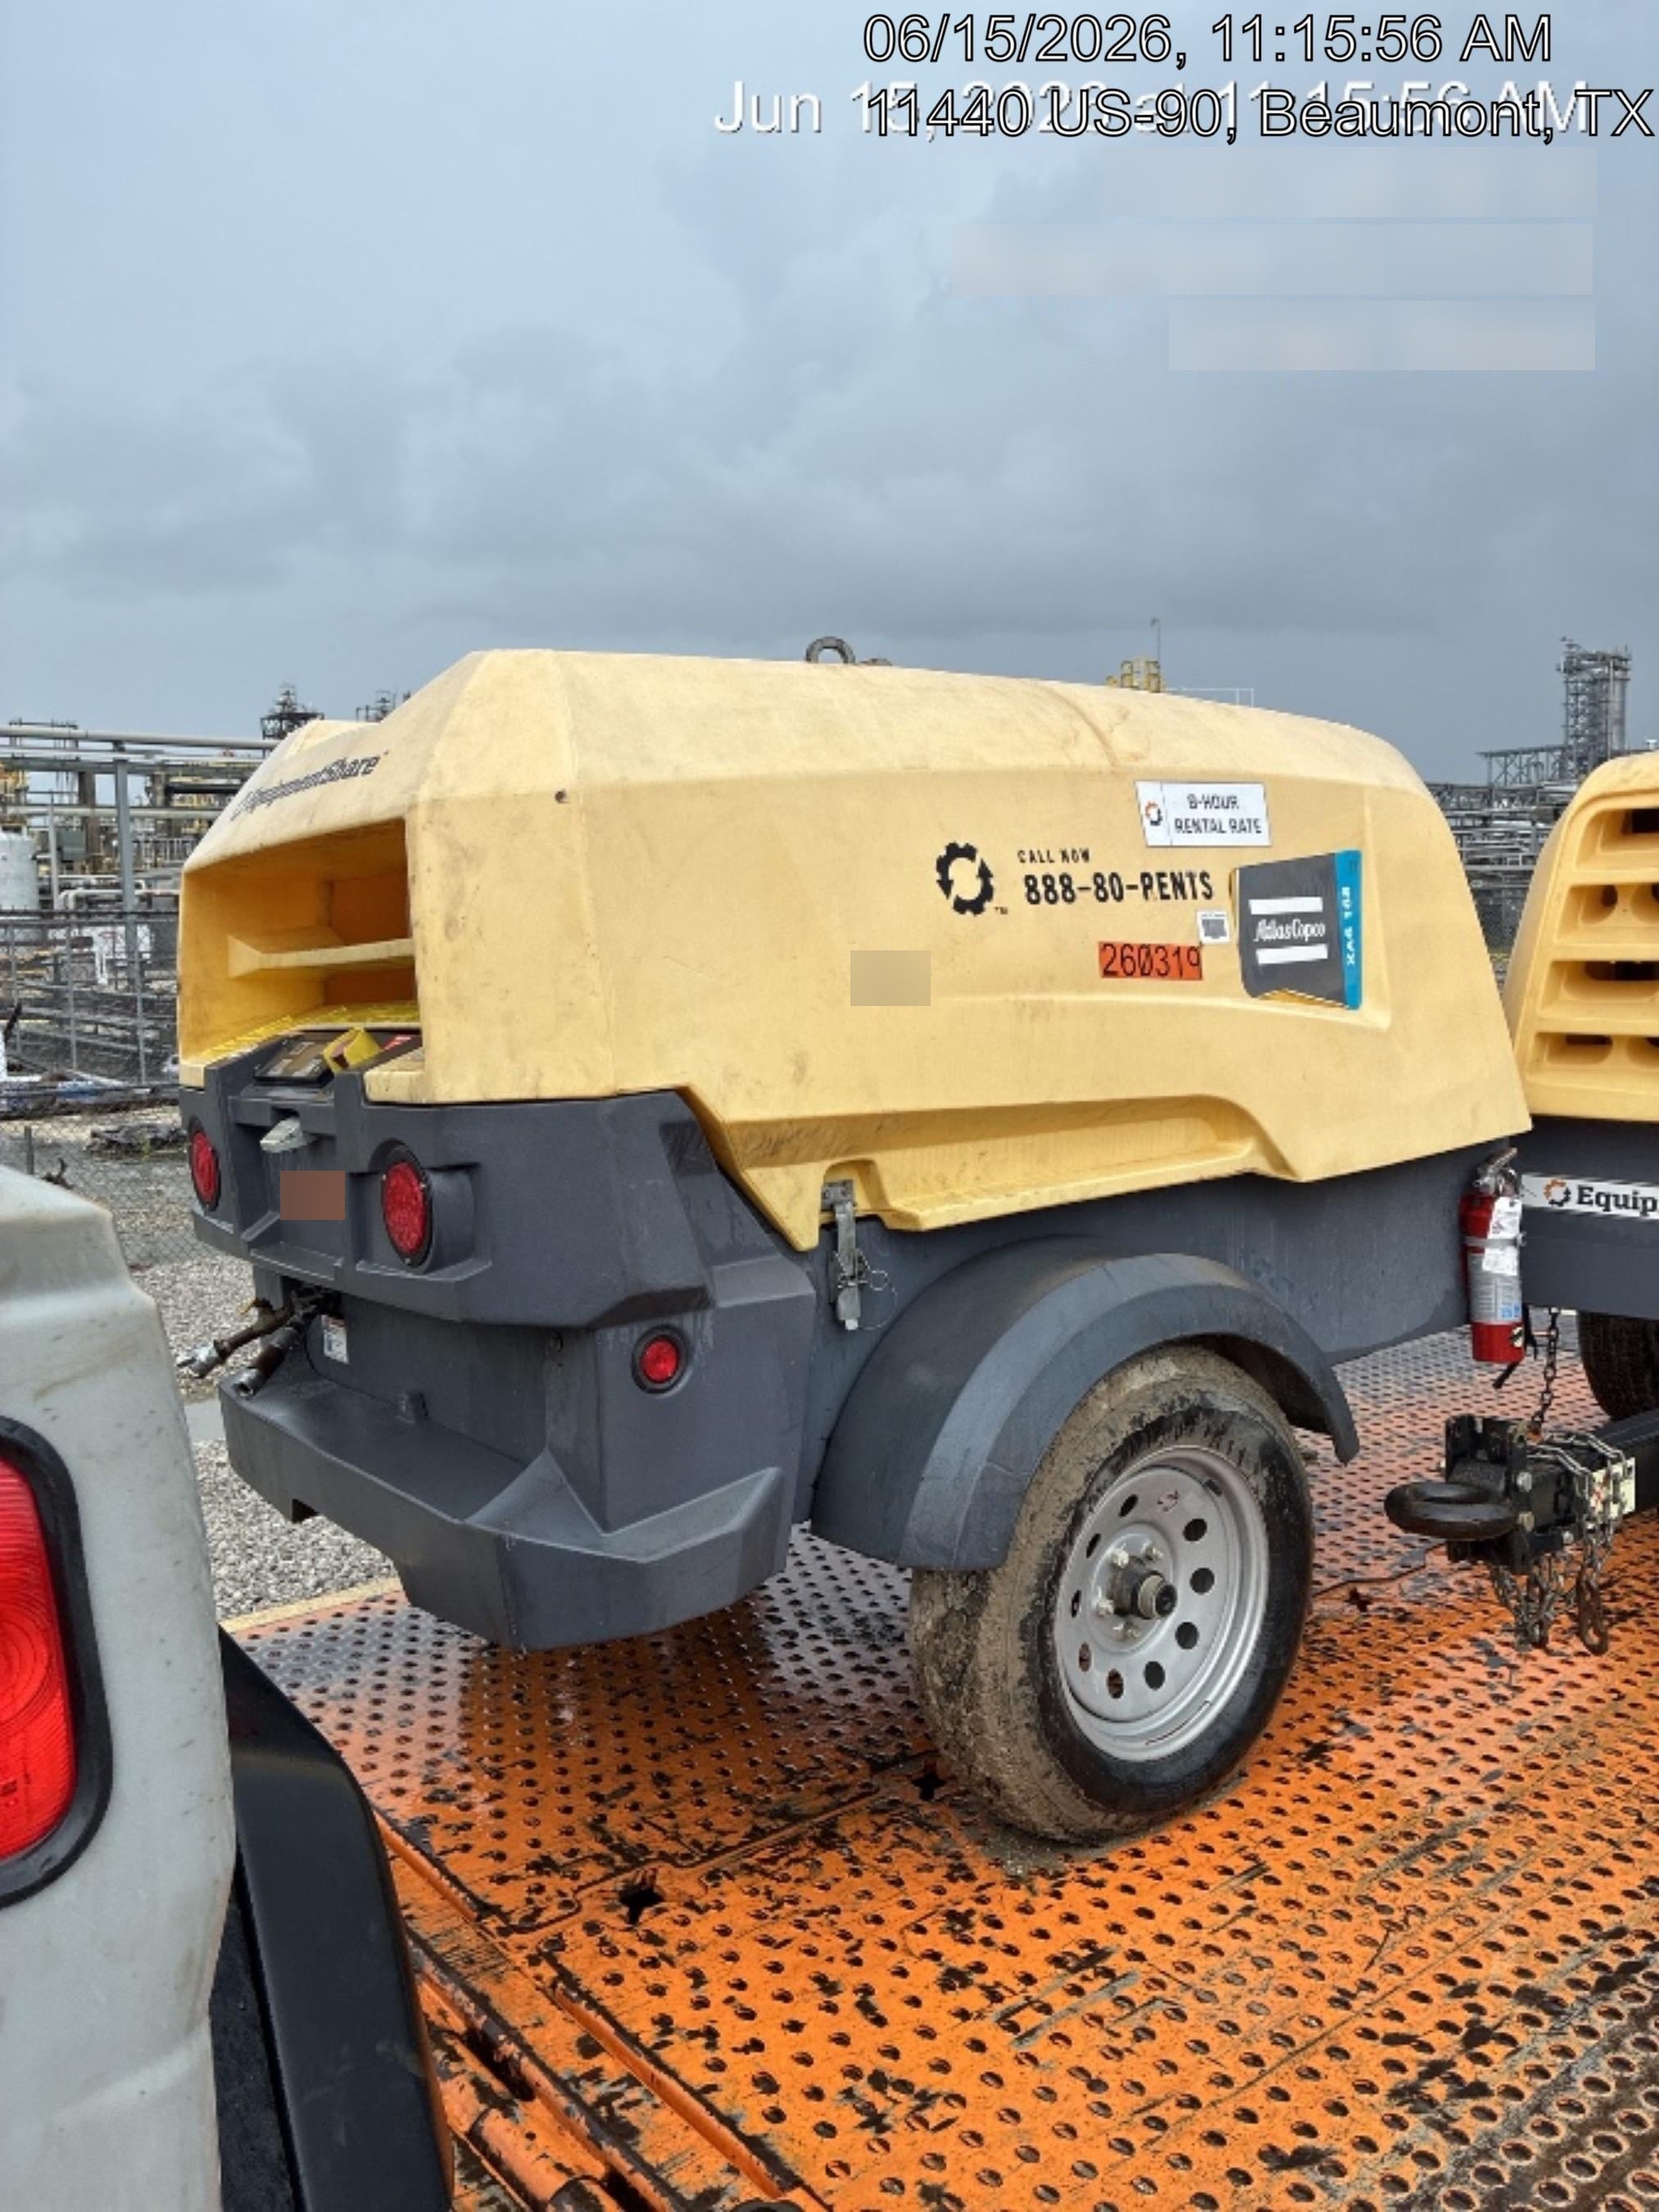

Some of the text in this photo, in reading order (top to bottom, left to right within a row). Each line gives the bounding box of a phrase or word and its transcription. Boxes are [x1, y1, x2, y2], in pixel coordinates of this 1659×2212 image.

[1174, 818, 1262, 834] RENTAL RATE
[1017, 848, 1090, 863] CALL NOW
[1100, 943, 1203, 979] 260319
[1577, 1185, 1658, 1217] Equip
